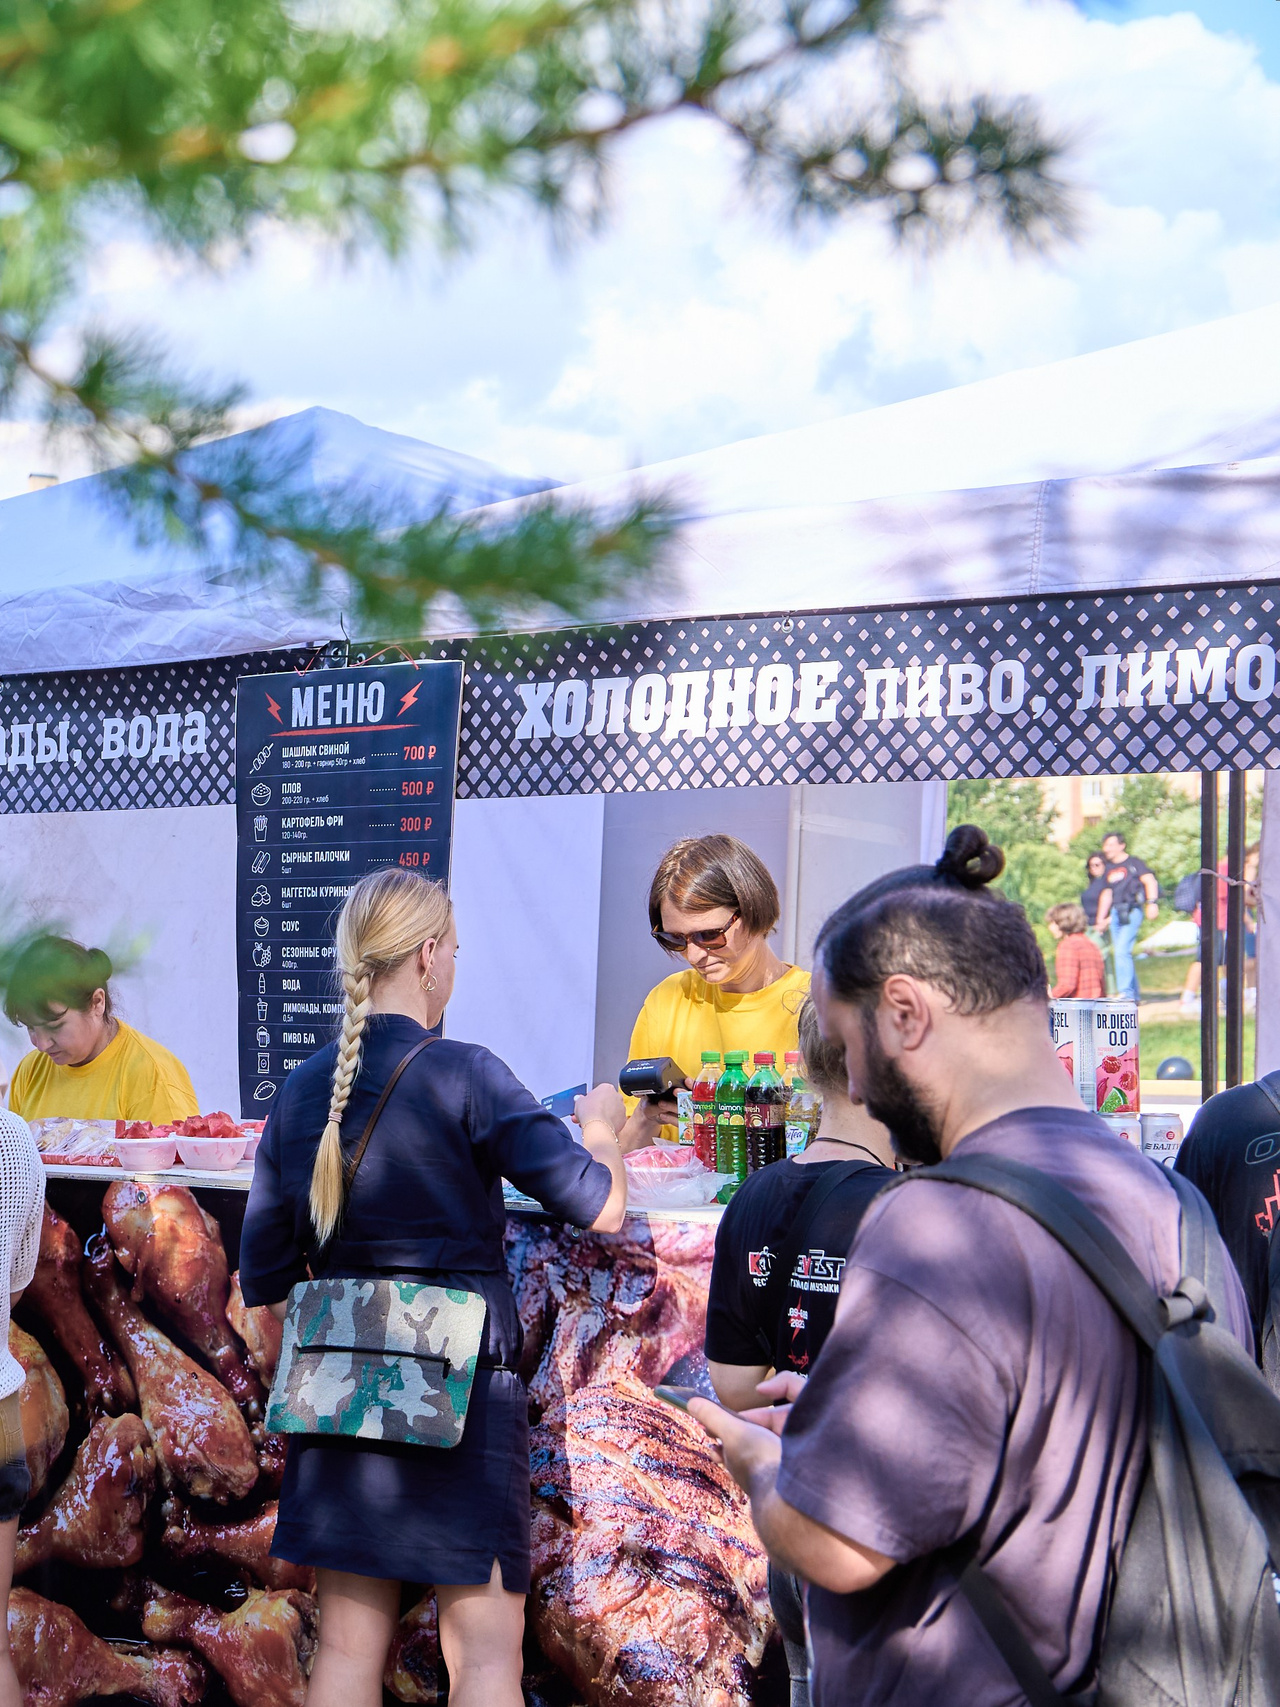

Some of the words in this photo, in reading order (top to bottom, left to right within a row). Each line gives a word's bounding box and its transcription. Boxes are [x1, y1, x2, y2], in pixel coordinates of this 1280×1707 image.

[515, 661, 840, 740] ХОЛОДНОЕ
[1076, 643, 1277, 711] лимо
[291, 680, 386, 728] МЕНЮ
[282, 746, 317, 758] ШАШЛЫК
[319, 741, 350, 755] СВИНОЙ
[403, 745, 425, 760] 700
[295, 760, 304, 768] 200
[353, 756, 366, 765] хлеб
[282, 782, 302, 794] ПЛОВ
[401, 781, 423, 796] 500
[282, 795, 303, 805] 200-220
[316, 794, 329, 803] хлеб
[281, 816, 325, 829] КАРТОФЕЛЬ
[326, 815, 344, 827] ФРИ
[400, 817, 421, 832] 300
[281, 851, 313, 863] СЫРНЫЕ
[314, 850, 350, 862] ПАЛОЧКИ
[398, 852, 419, 867] 450
[282, 866, 292, 874] 5шт
[281, 886, 318, 898] НАГГЕТСЫ
[281, 901, 292, 909] 6шт
[281, 920, 300, 932] СОУС
[281, 946, 320, 958] СЕЗОННЫЕ
[321, 946, 337, 958] ФРУ
[282, 979, 301, 991] ВОДА
[282, 1003, 322, 1015] ЛИМОНАДЫ,
[322, 1003, 346, 1015] КОМПО
[1054, 1013, 1069, 1028] ESEL
[283, 1032, 302, 1044] ПИВО
[303, 1033, 316, 1045] Б/А
[1109, 1031, 1128, 1047] 0.0
[283, 1058, 306, 1070] СНЕ
